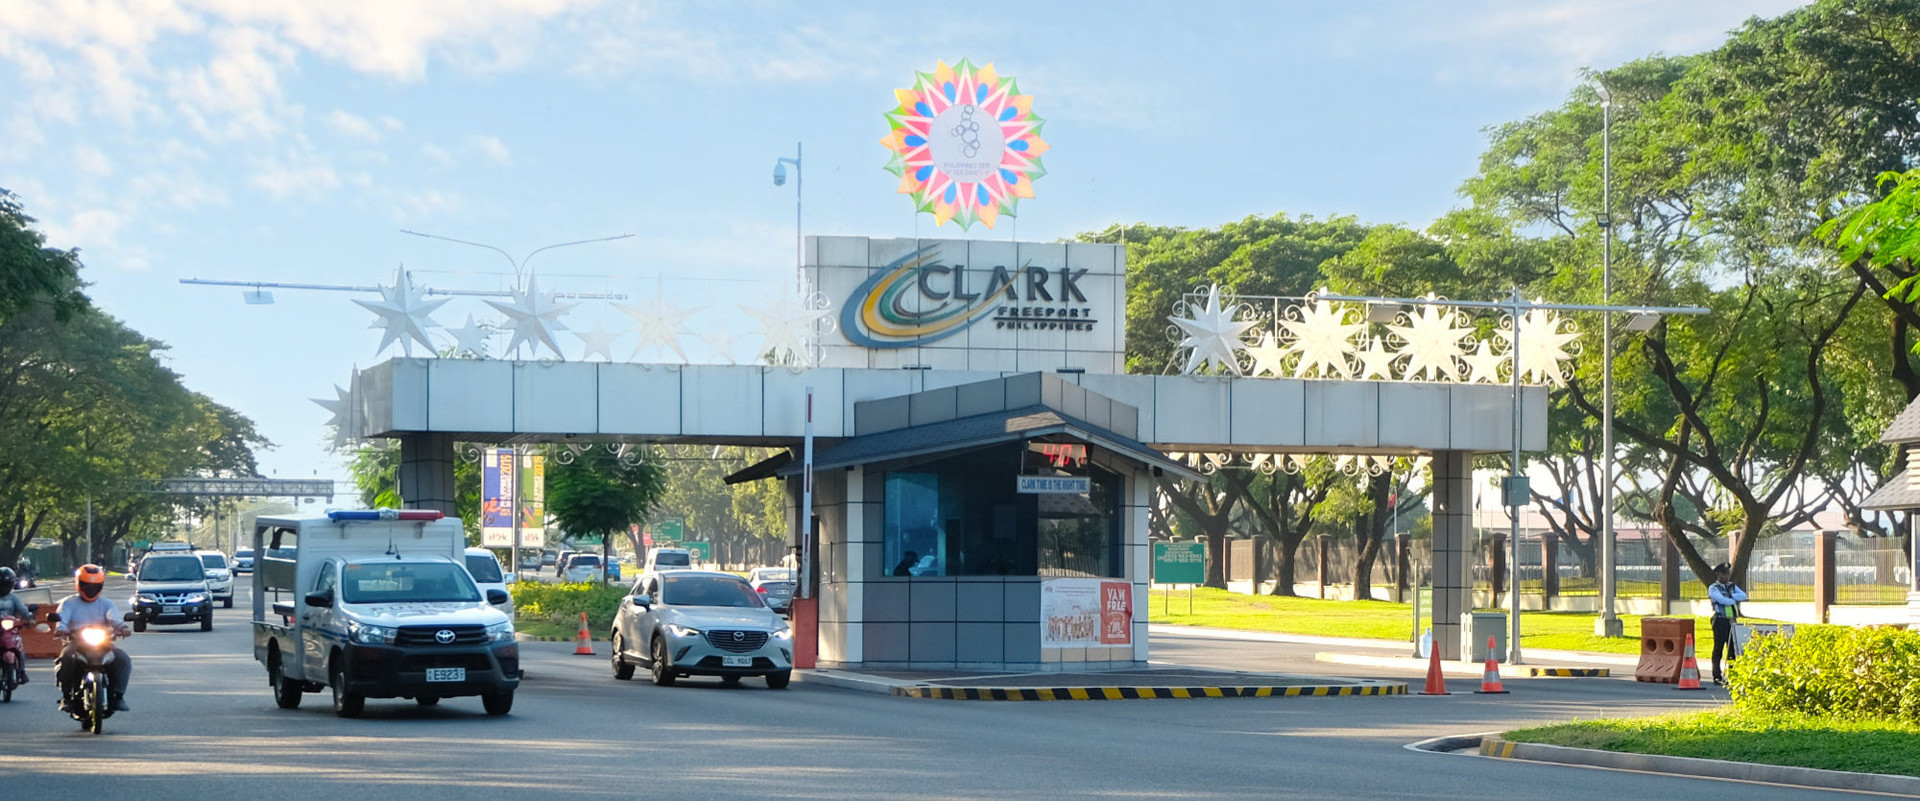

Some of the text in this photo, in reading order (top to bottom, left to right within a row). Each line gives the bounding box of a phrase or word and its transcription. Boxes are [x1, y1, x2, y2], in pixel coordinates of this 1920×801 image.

[919, 264, 1089, 302] CLARK
[998, 306, 1092, 318] FREEPORT
[996, 321, 1093, 331] PHILIPPINES
[1021, 479, 1036, 490] CLARK
[1036, 479, 1047, 490] TIME
[1053, 479, 1062, 490] THE
[1062, 479, 1075, 490] RIGHT
[1075, 479, 1086, 490] TIME
[434, 669, 459, 680] E923
